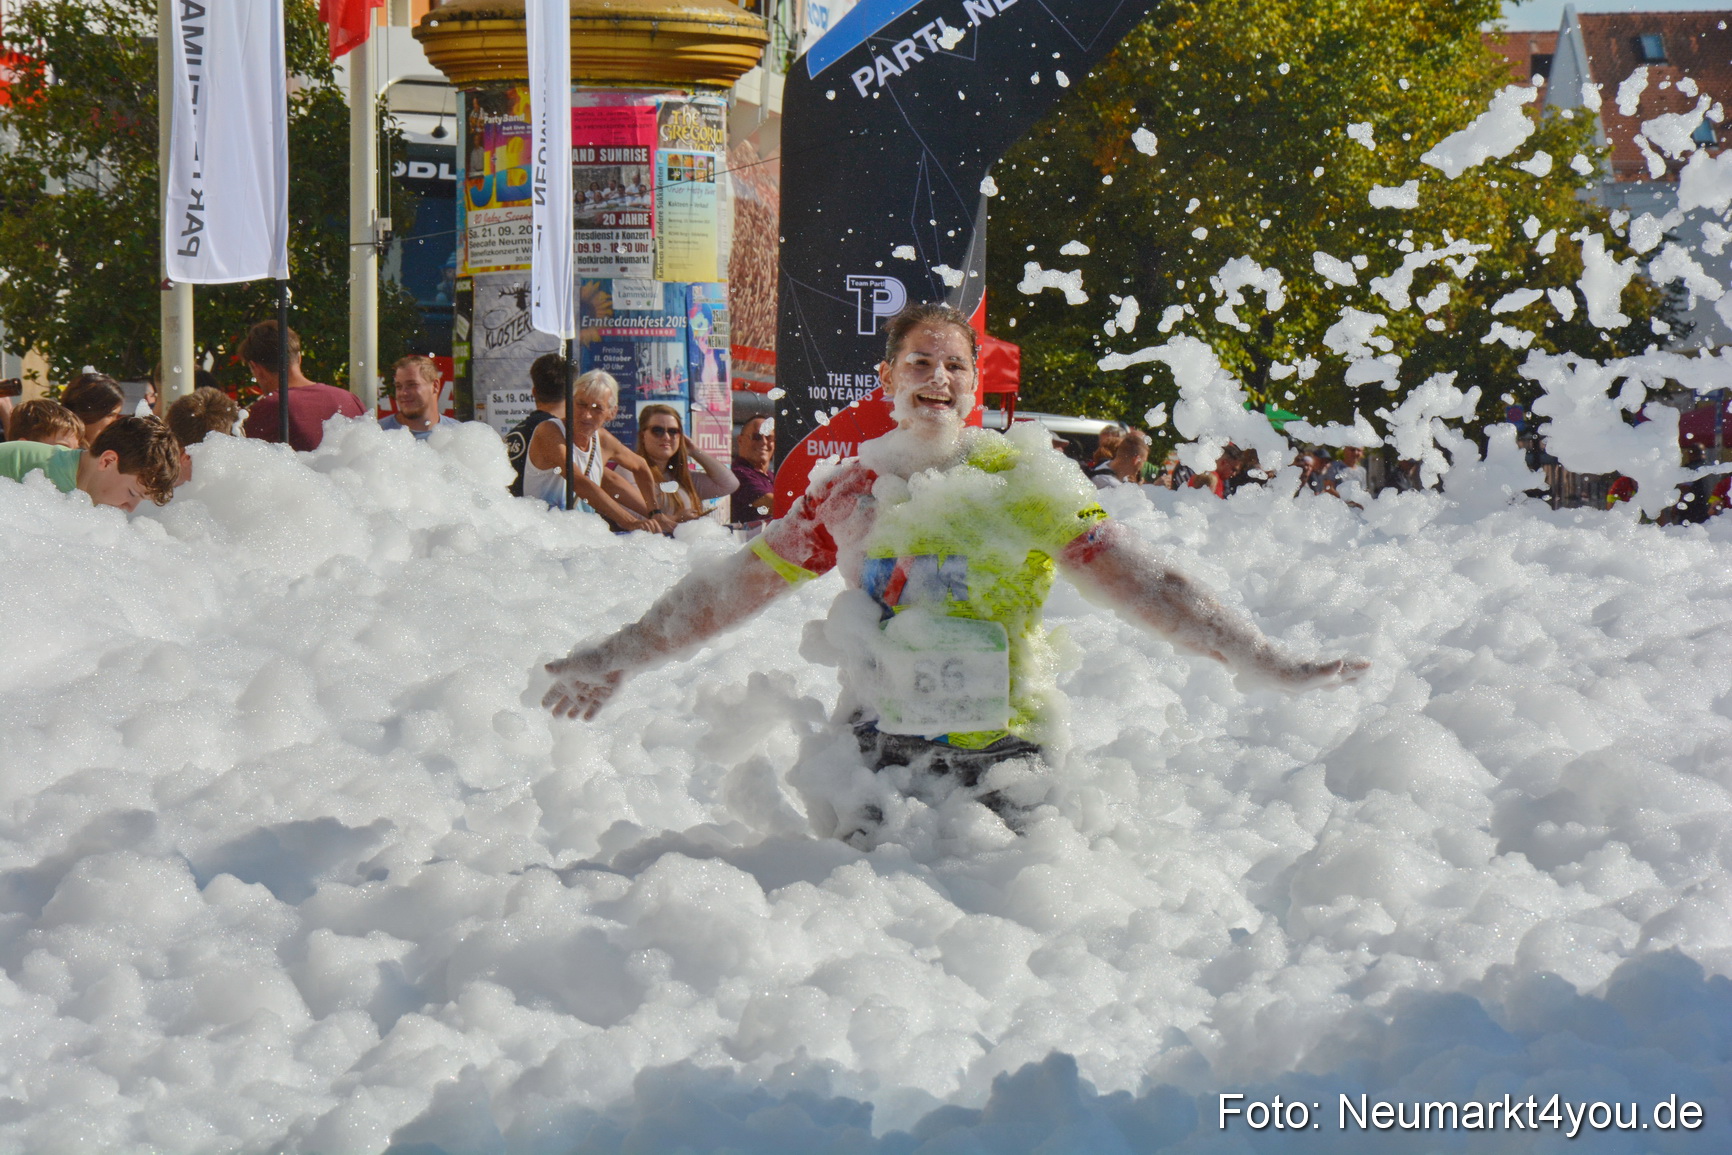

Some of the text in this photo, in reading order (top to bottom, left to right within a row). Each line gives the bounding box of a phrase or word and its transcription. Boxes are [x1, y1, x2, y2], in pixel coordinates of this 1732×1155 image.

[599, 147, 648, 163] SUNRISE
[603, 212, 649, 226] 20 JAHRE
[656, 211, 665, 235] andere
[481, 227, 496, 238] 21.
[498, 226, 515, 237] 09.
[621, 230, 649, 240] Konzert
[635, 242, 649, 253] Uhr
[656, 235, 665, 250] und
[577, 254, 650, 265] Hofkirche Neumarkt
[850, 279, 869, 287] Team
[581, 315, 687, 329] Erntedankfest 2019
[602, 346, 624, 355] Freitag
[603, 354, 632, 362] Oktober
[827, 373, 852, 387] THE
[492, 393, 504, 404] Sa.
[506, 392, 517, 403] 19.
[808, 387, 873, 401] 100 YEARS
[611, 421, 625, 429] Uhr
[806, 439, 853, 457] BMW
